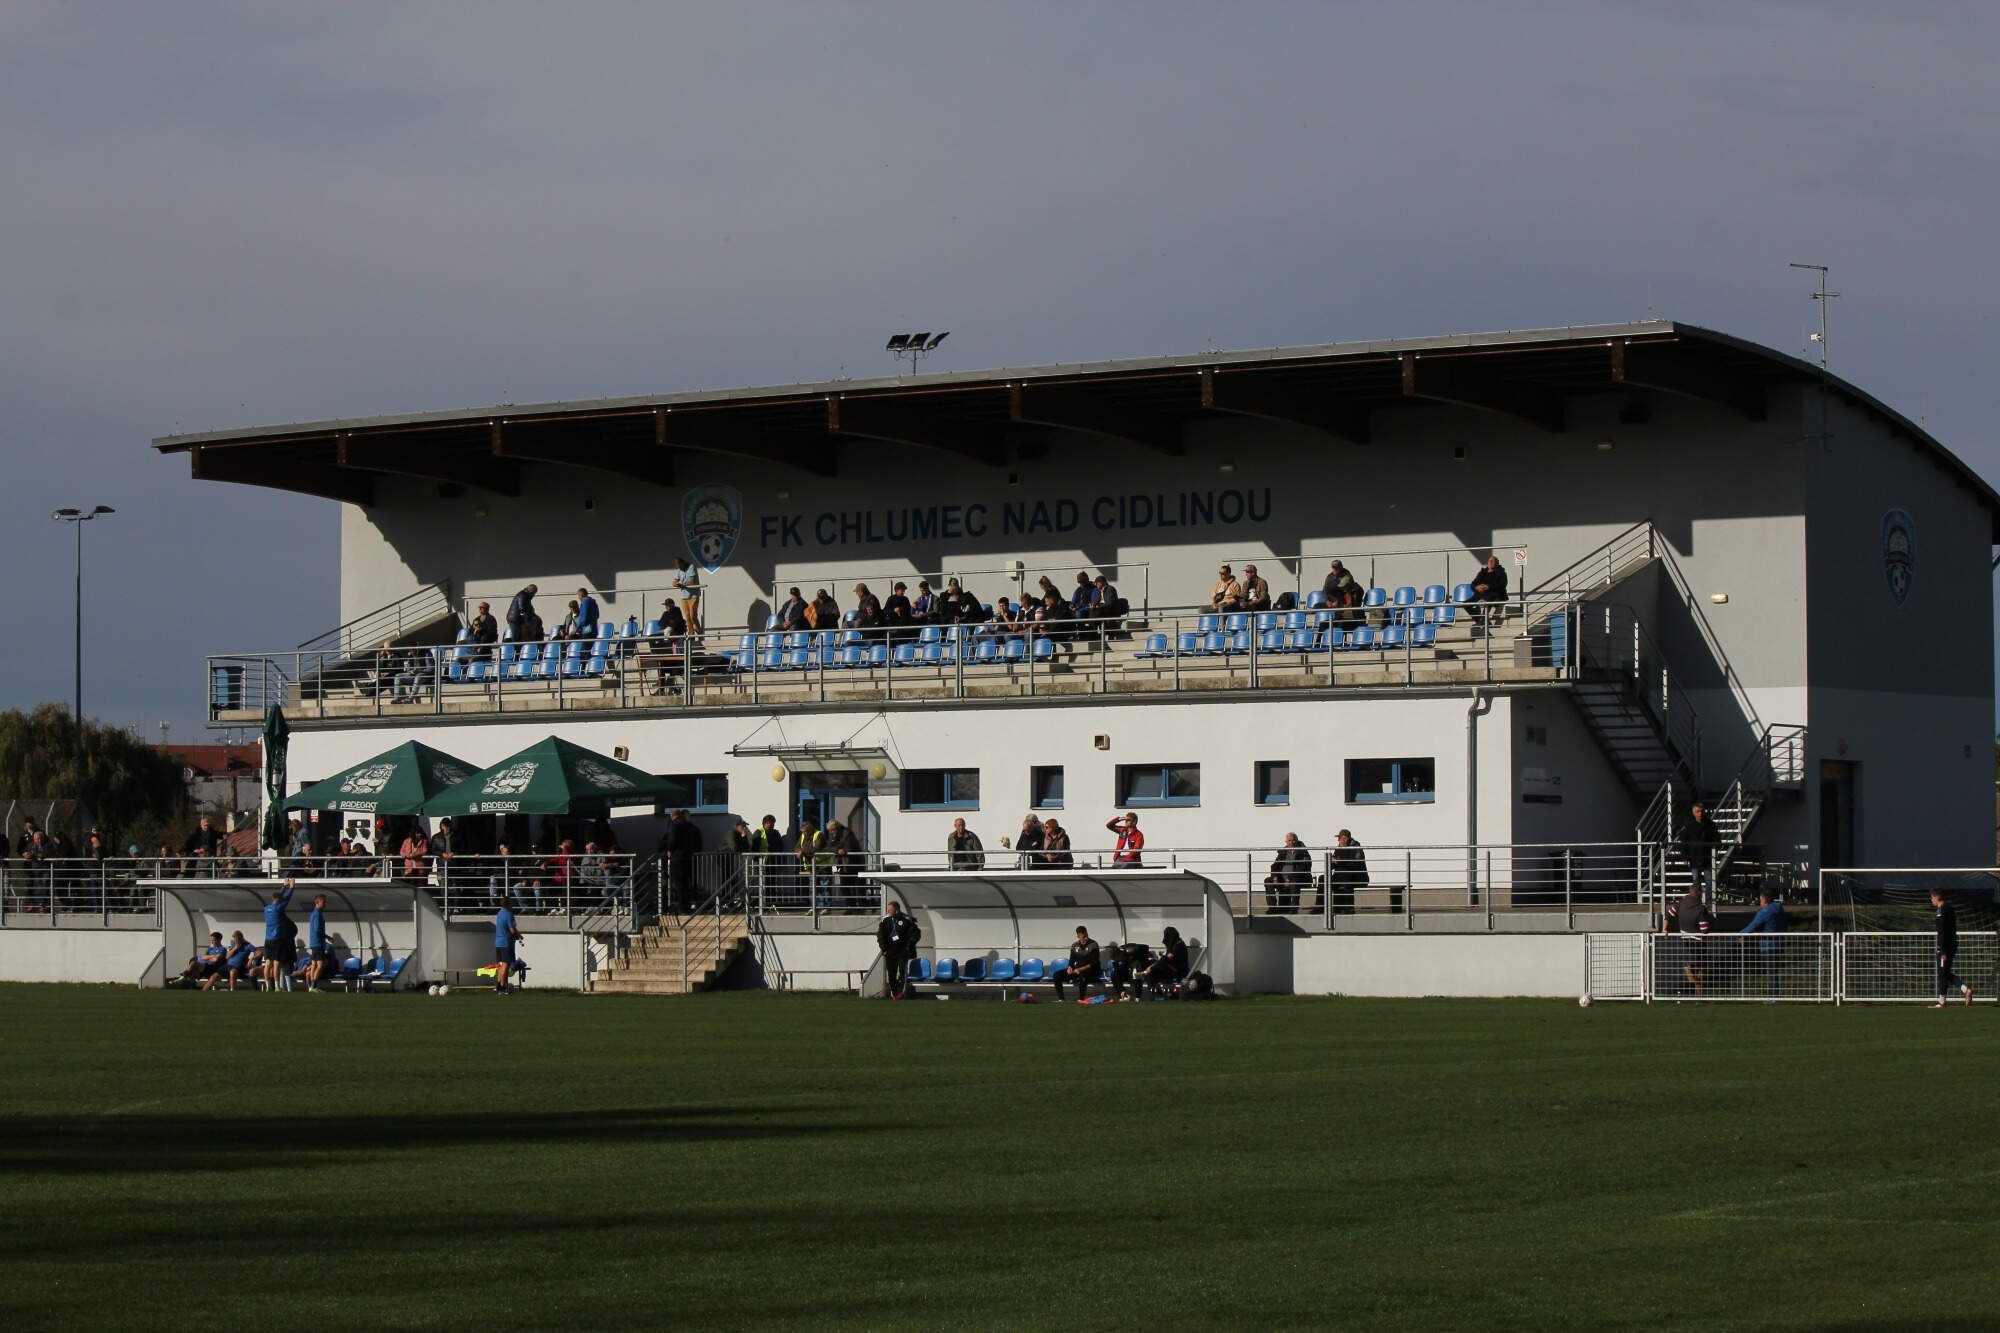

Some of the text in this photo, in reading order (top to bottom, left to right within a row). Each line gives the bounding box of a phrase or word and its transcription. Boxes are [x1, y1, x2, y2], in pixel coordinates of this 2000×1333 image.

[760, 487, 1272, 548] FK CHLUMEC NAD CIDLINOU
[340, 800, 379, 812] RADEGAST
[481, 801, 520, 812] RADEGAST
